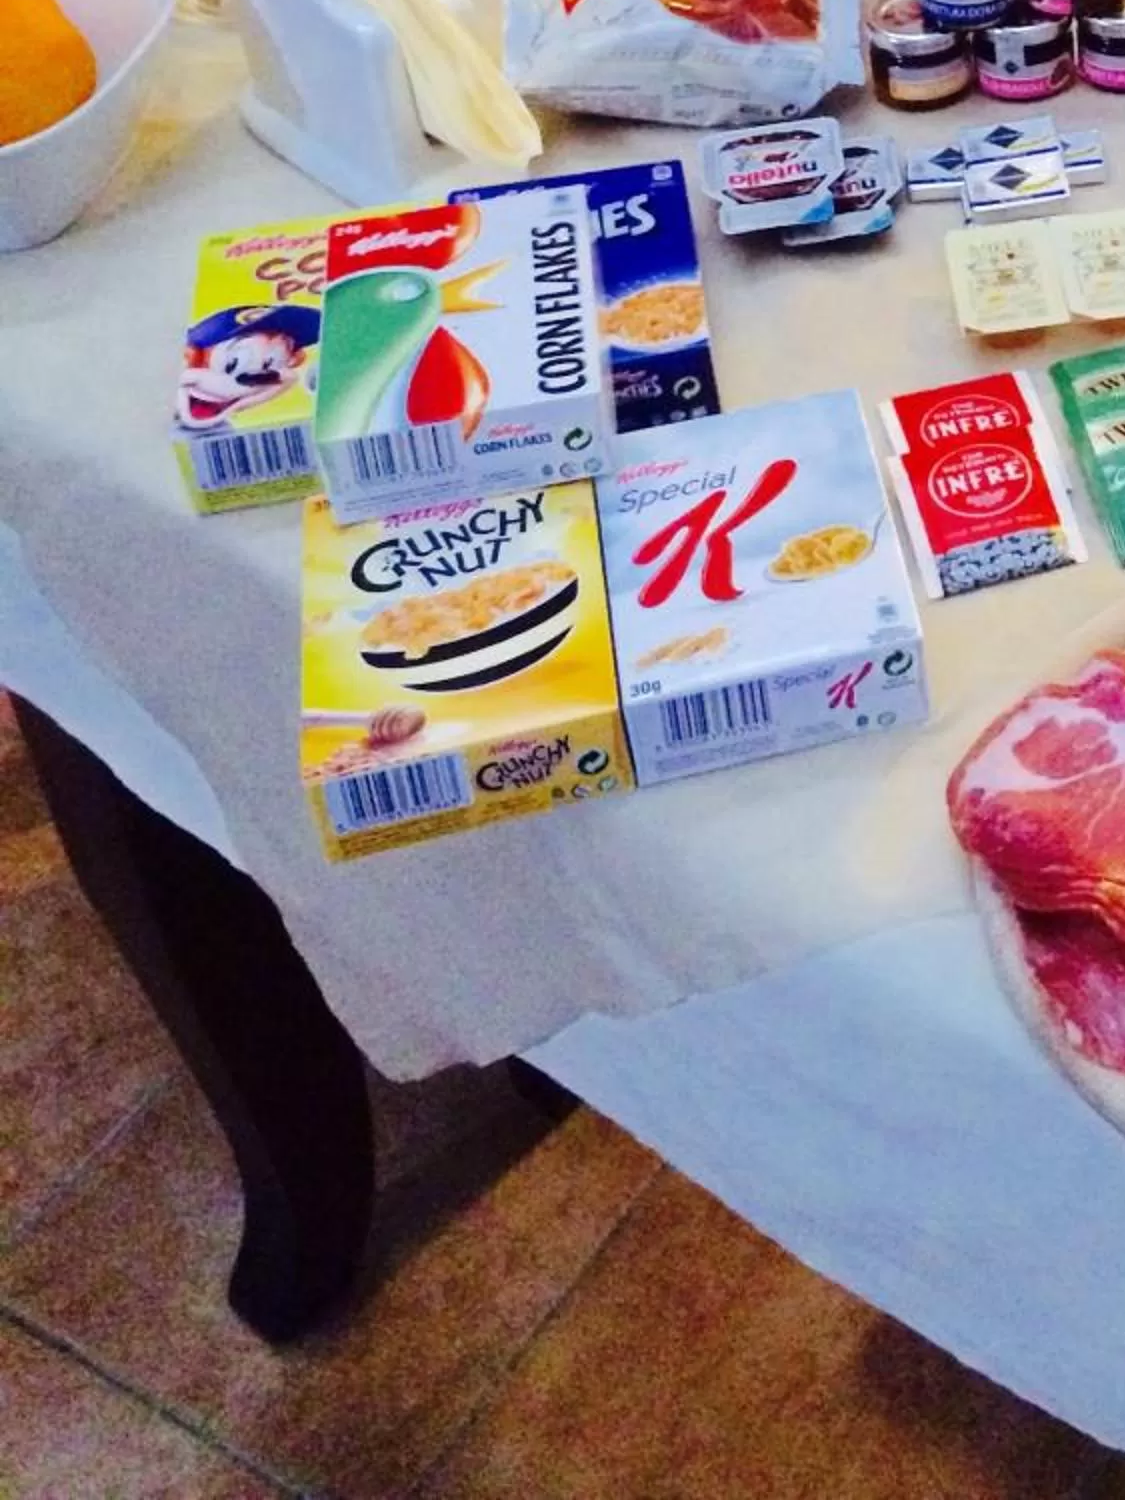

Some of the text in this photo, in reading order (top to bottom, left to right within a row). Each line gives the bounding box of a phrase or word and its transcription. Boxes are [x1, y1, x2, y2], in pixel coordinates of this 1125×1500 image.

[728, 160, 818, 187] nutella
[531, 222, 587, 395] CORN FLAKES
[618, 465, 737, 515] Special
[350, 492, 546, 594] CRUNCHY
[632, 458, 798, 608] K
[417, 537, 512, 587] NUT
[630, 678, 662, 698] 30g
[826, 661, 874, 710] K
[476, 733, 571, 791] CRUNCHY
